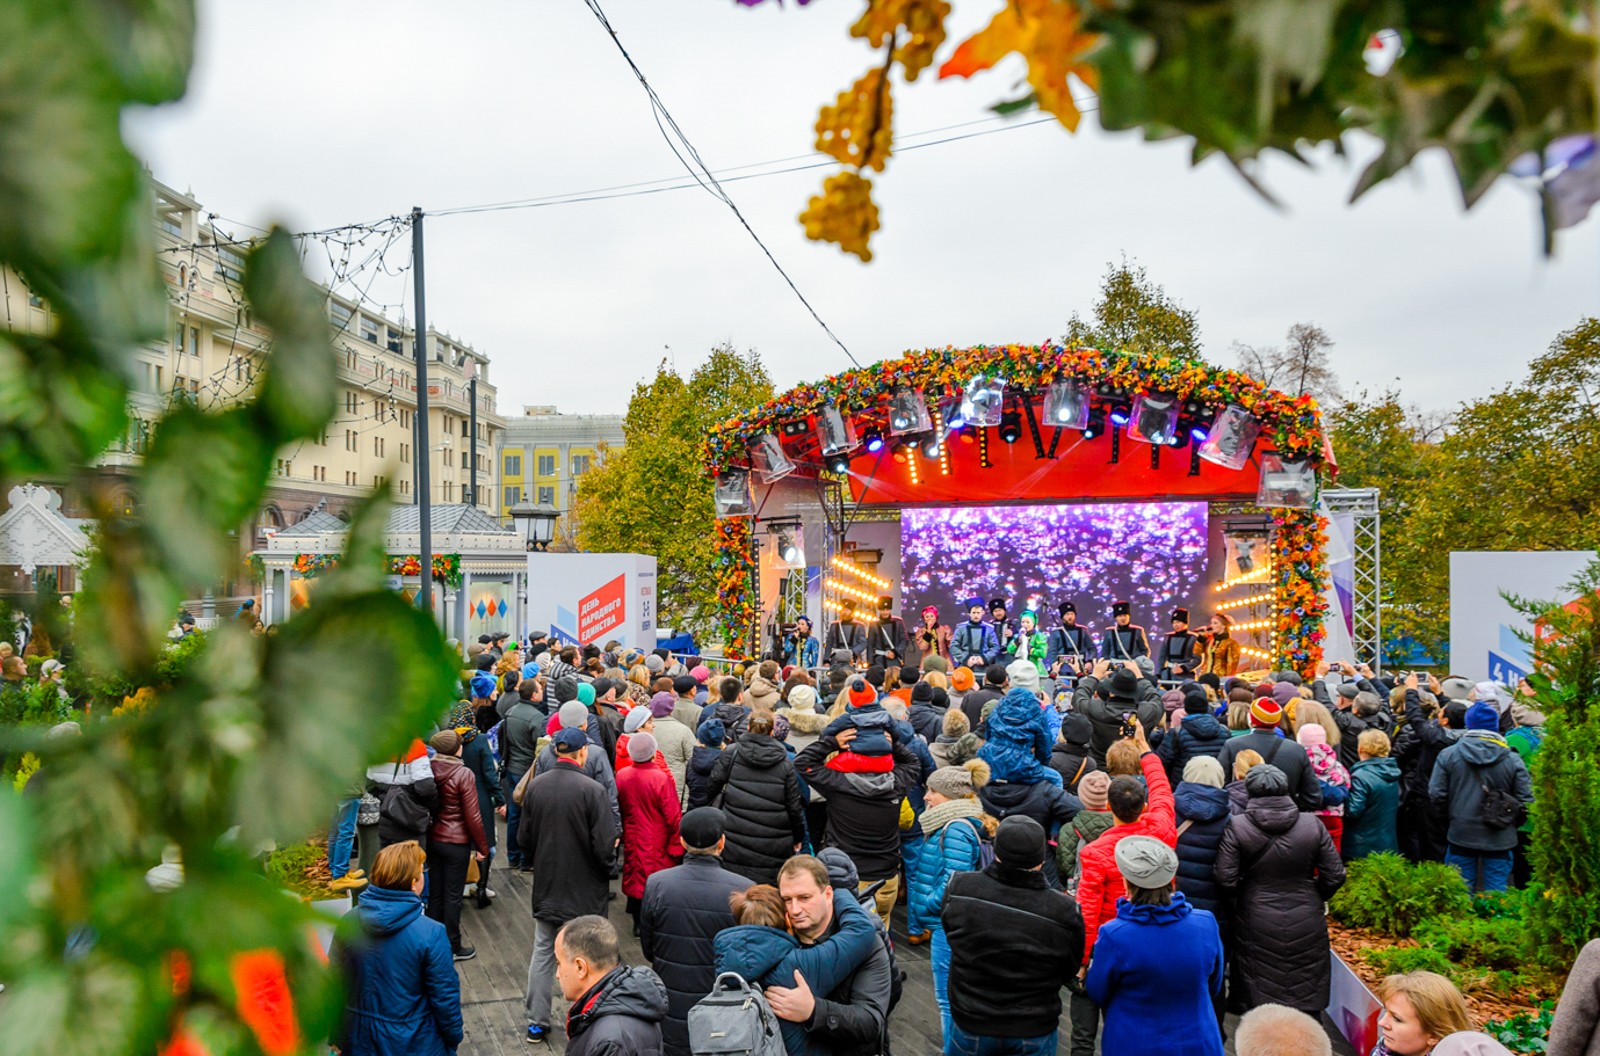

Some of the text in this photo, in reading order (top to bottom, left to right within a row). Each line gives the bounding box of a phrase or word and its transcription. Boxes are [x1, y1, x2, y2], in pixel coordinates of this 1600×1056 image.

[581, 597, 600, 616] ДЕНЬ
[581, 597, 621, 628] НАРОДНОГО
[581, 614, 616, 641] ЕДИНСТВА
[1493, 662, 1504, 681] 4
